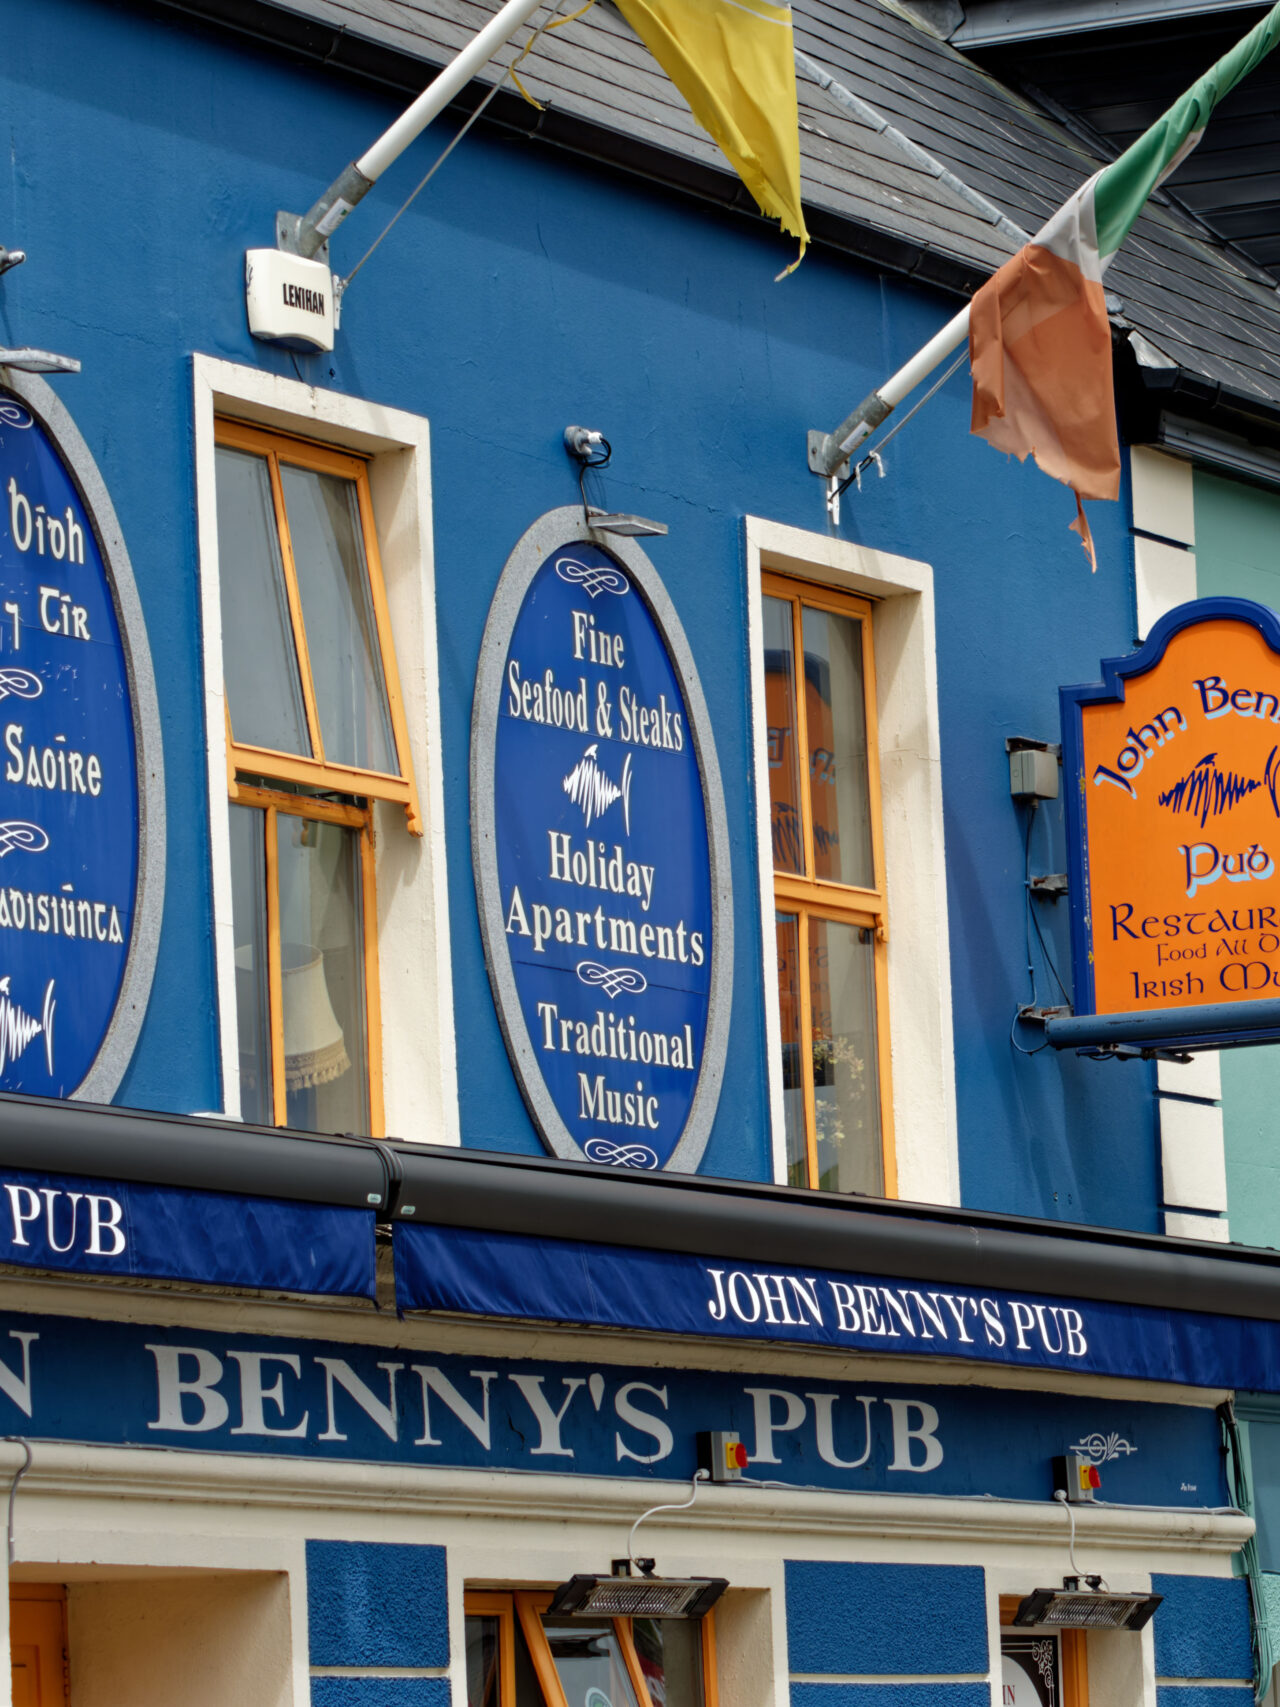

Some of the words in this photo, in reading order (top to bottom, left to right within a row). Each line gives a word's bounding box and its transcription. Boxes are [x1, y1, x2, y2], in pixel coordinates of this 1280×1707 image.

[282, 283, 325, 317] LENIHAN
[571, 610, 625, 669] Fine
[508, 659, 589, 733] Seafood
[596, 681, 613, 738] &
[619, 685, 684, 751] Steaks
[1093, 706, 1188, 799] John
[547, 830, 655, 911] Holiday
[1178, 842, 1275, 898] Pub
[505, 885, 704, 967] Apartments
[1156, 942, 1207, 967] Food
[1215, 938, 1249, 957] All
[537, 1002, 695, 1070] Traditional
[577, 1072, 659, 1130] Music
[3, 1184, 126, 1256] PUB
[706, 1268, 824, 1328] JOHN
[827, 1280, 1007, 1348] BENNY'S
[1007, 1301, 1088, 1357] PUB
[144, 1343, 674, 1464] BENNY'S
[743, 1388, 945, 1474] PUB
